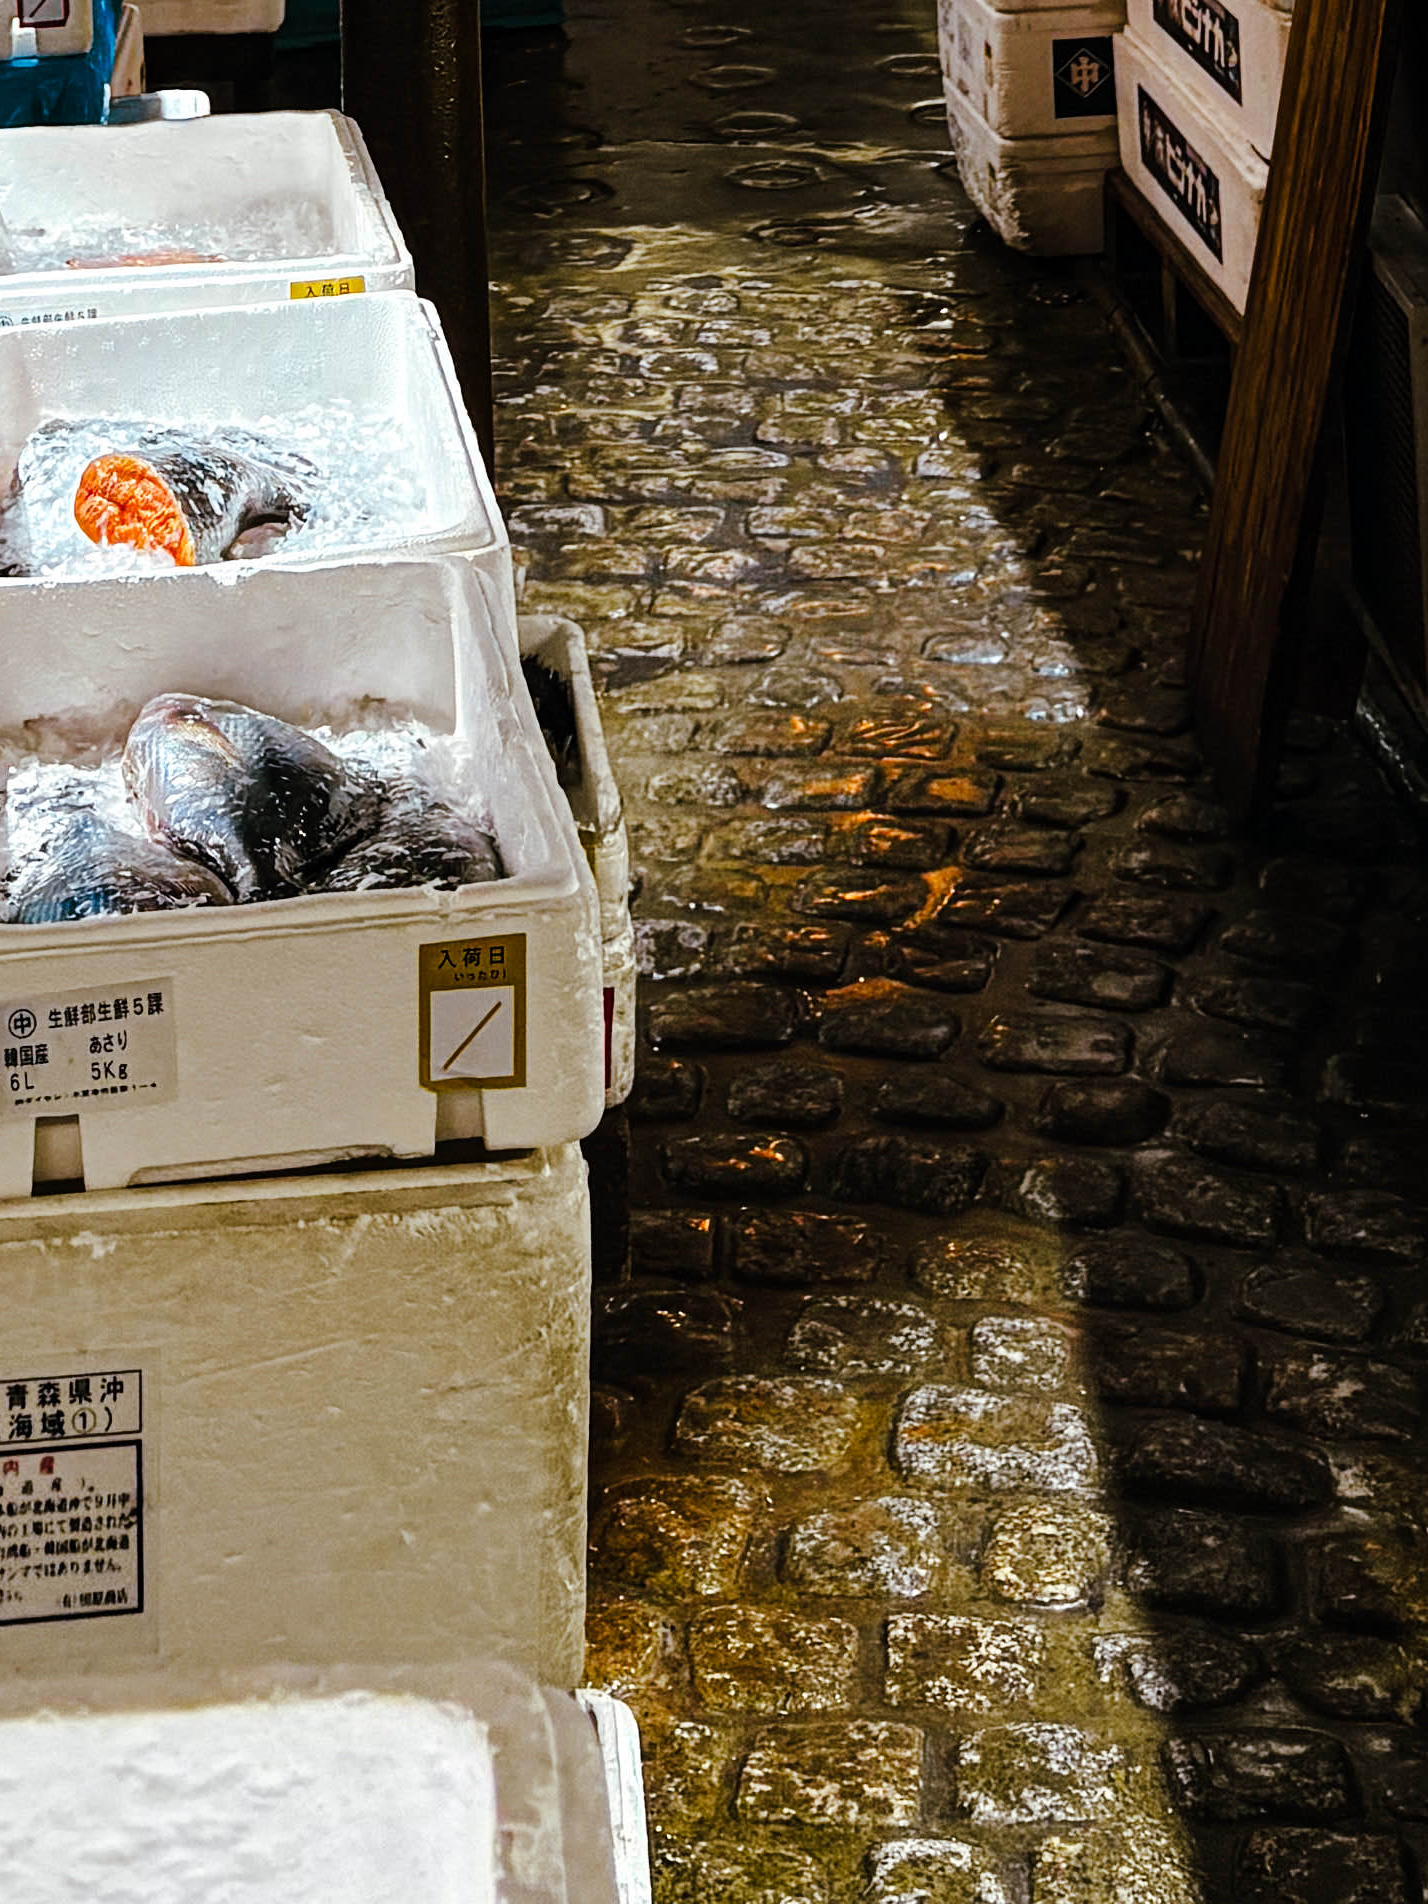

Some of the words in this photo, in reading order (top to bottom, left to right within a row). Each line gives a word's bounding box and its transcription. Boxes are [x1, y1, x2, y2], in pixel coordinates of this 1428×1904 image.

[437, 945, 507, 971] 入荷日
[88, 1030, 128, 1054] あさり
